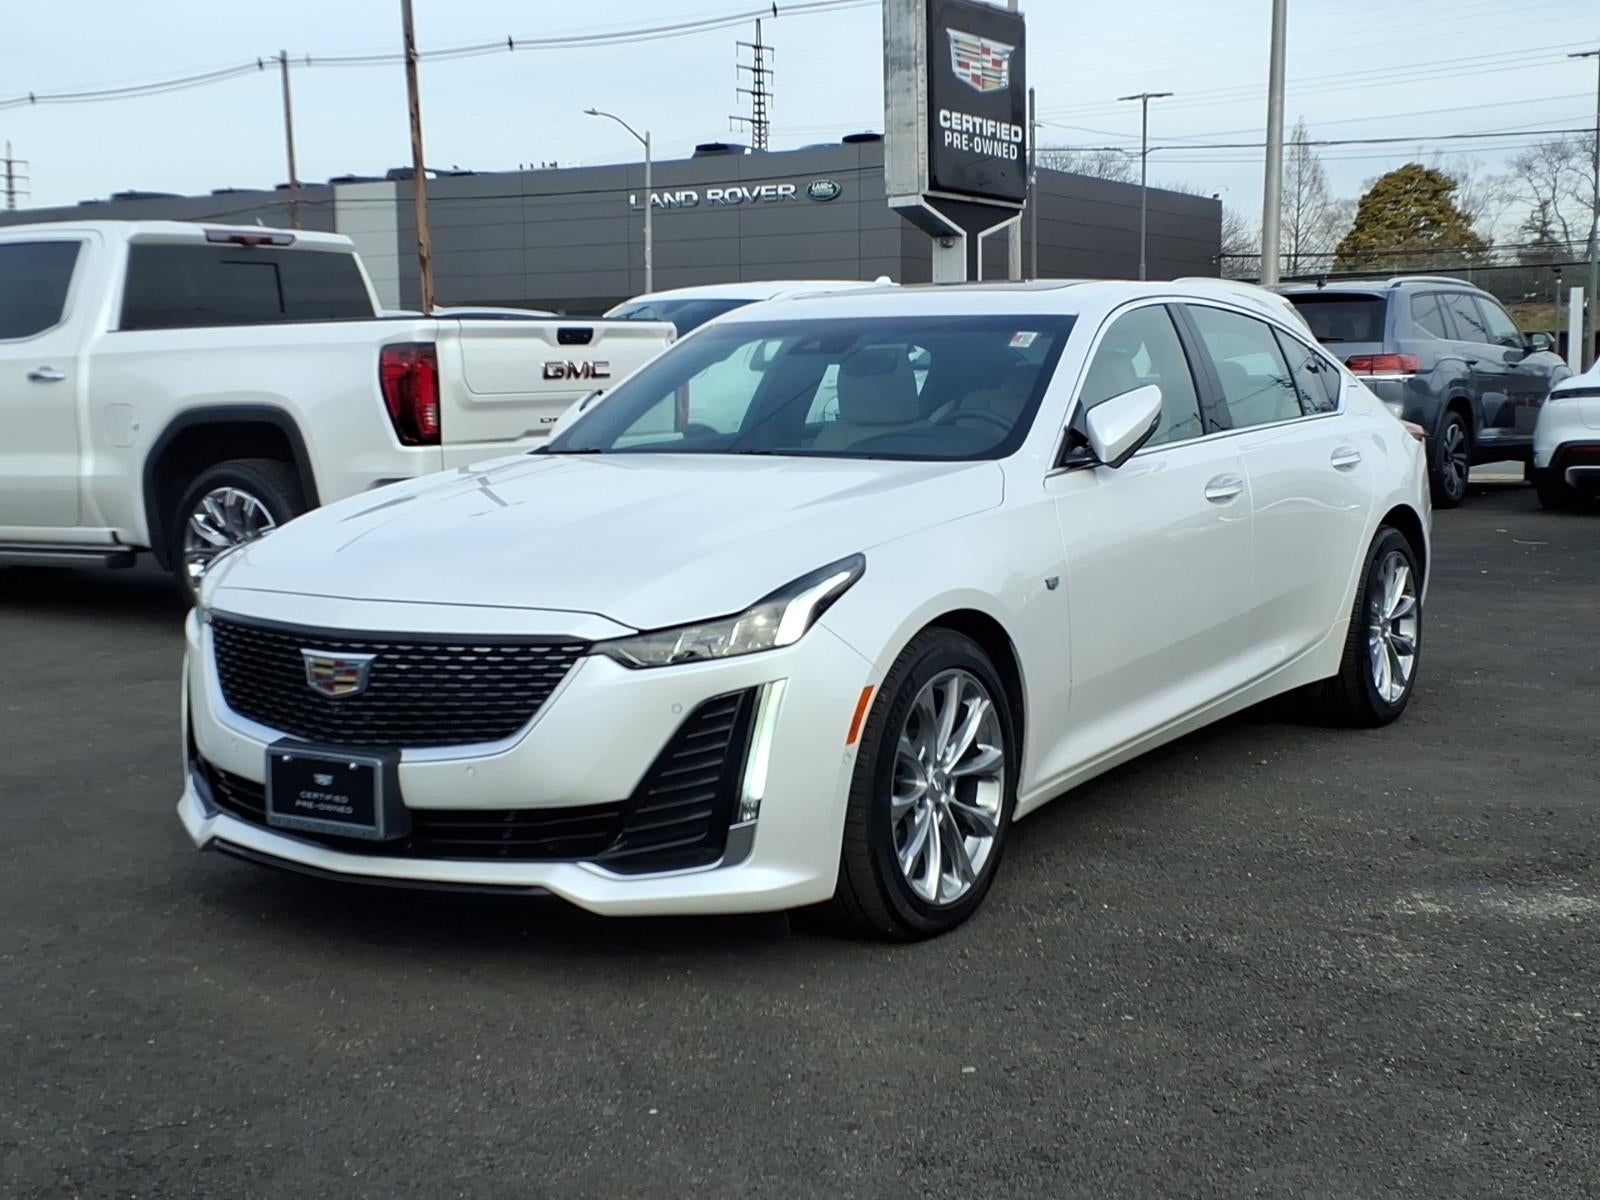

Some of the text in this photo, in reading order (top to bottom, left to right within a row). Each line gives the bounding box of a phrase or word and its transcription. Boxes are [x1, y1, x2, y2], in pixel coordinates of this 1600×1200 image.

[940, 109, 1023, 142] CERTIFIED
[944, 131, 1018, 160] PRE-OWNED
[630, 184, 796, 209] LAND ROVER
[542, 360, 610, 380] GMC
[295, 799, 354, 815] PRE-OWNED
[299, 790, 349, 804] CERTIFIED
